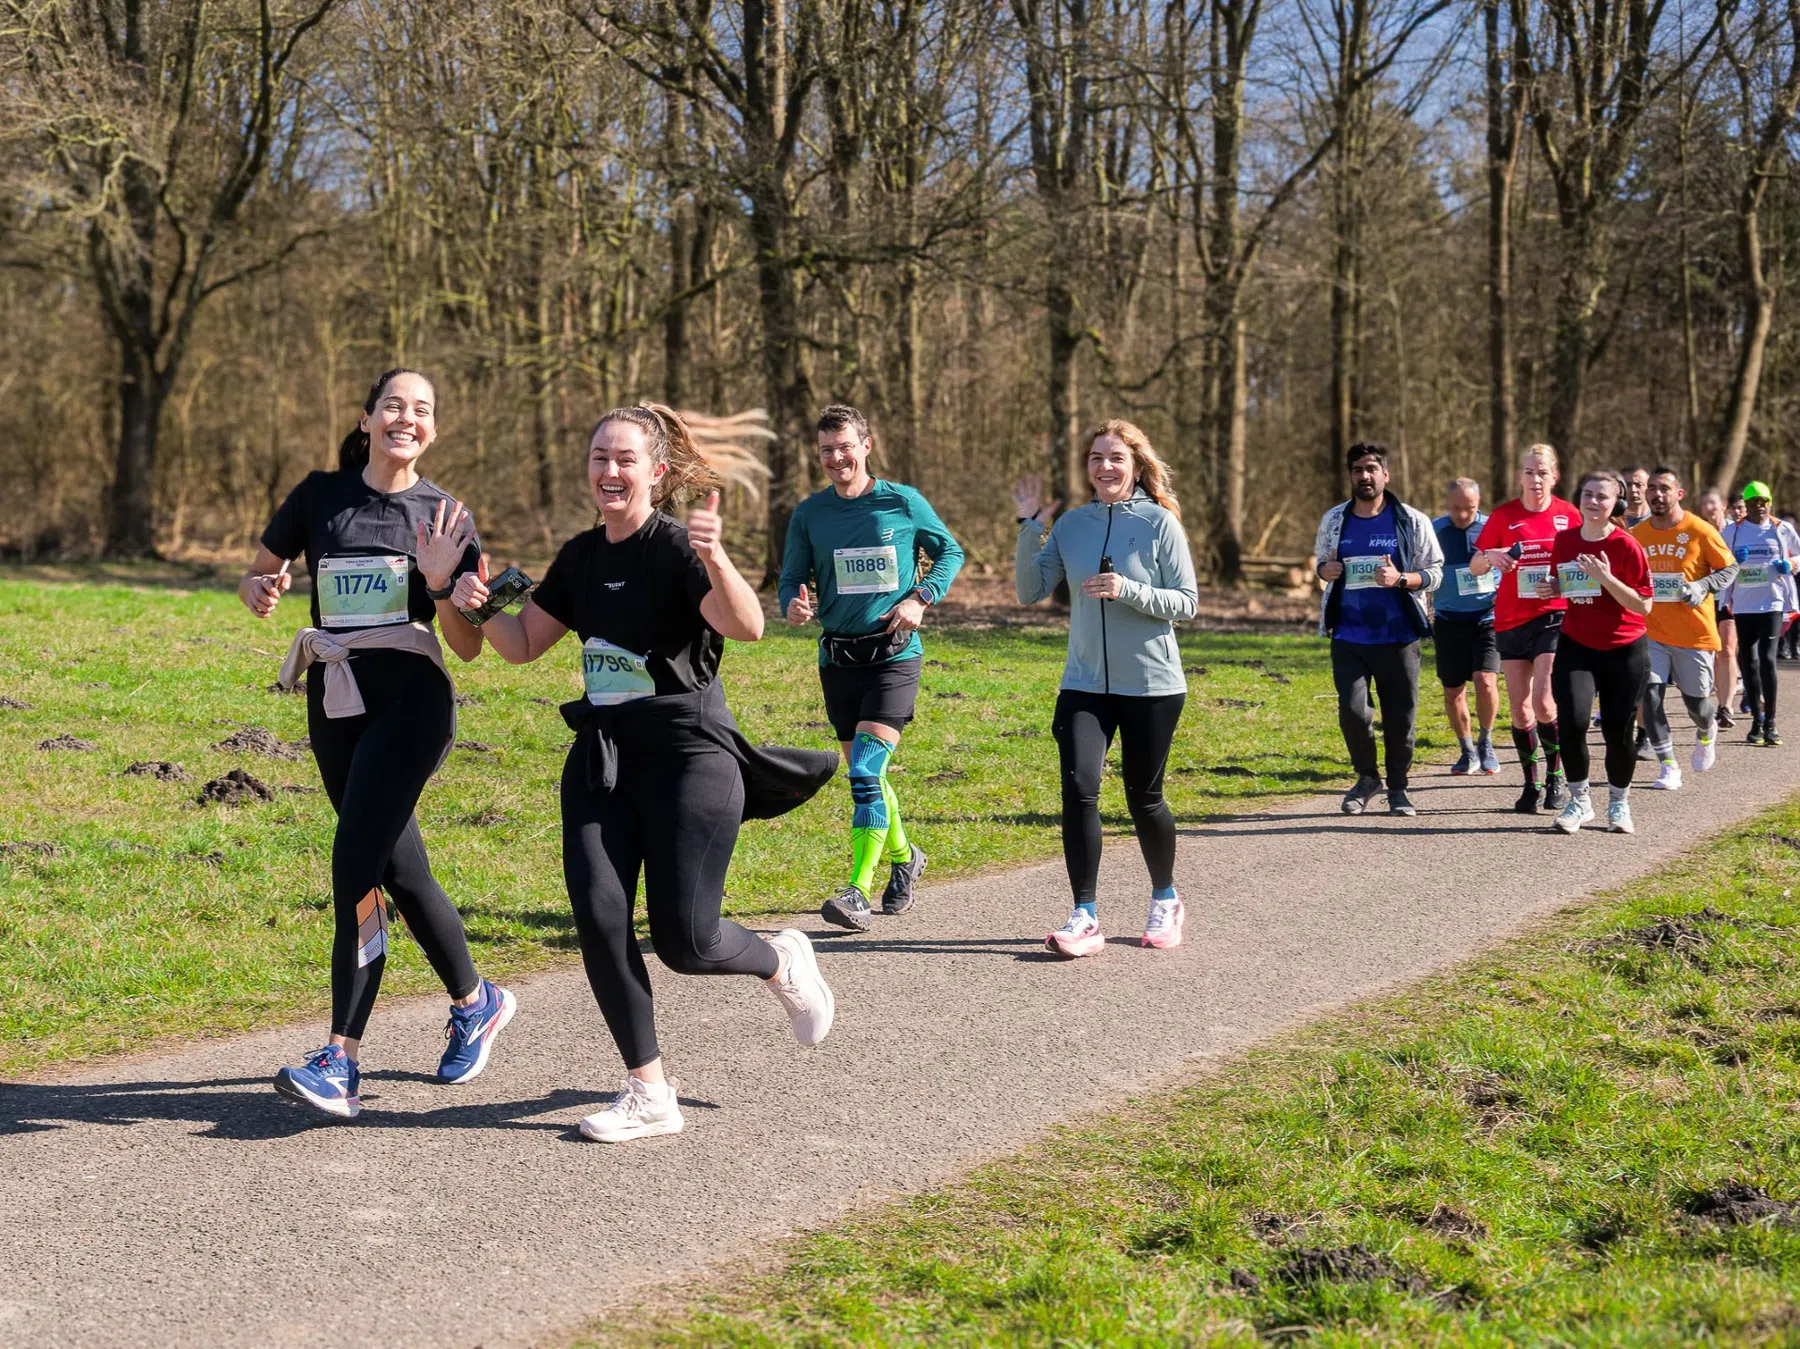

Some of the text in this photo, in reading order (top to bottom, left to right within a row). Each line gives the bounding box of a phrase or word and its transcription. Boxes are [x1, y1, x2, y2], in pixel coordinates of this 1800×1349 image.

[1368, 539, 1398, 547] KPMG
[845, 558, 886, 573] 11888
[334, 573, 388, 595] 11774
[583, 654, 633, 673] 11796
